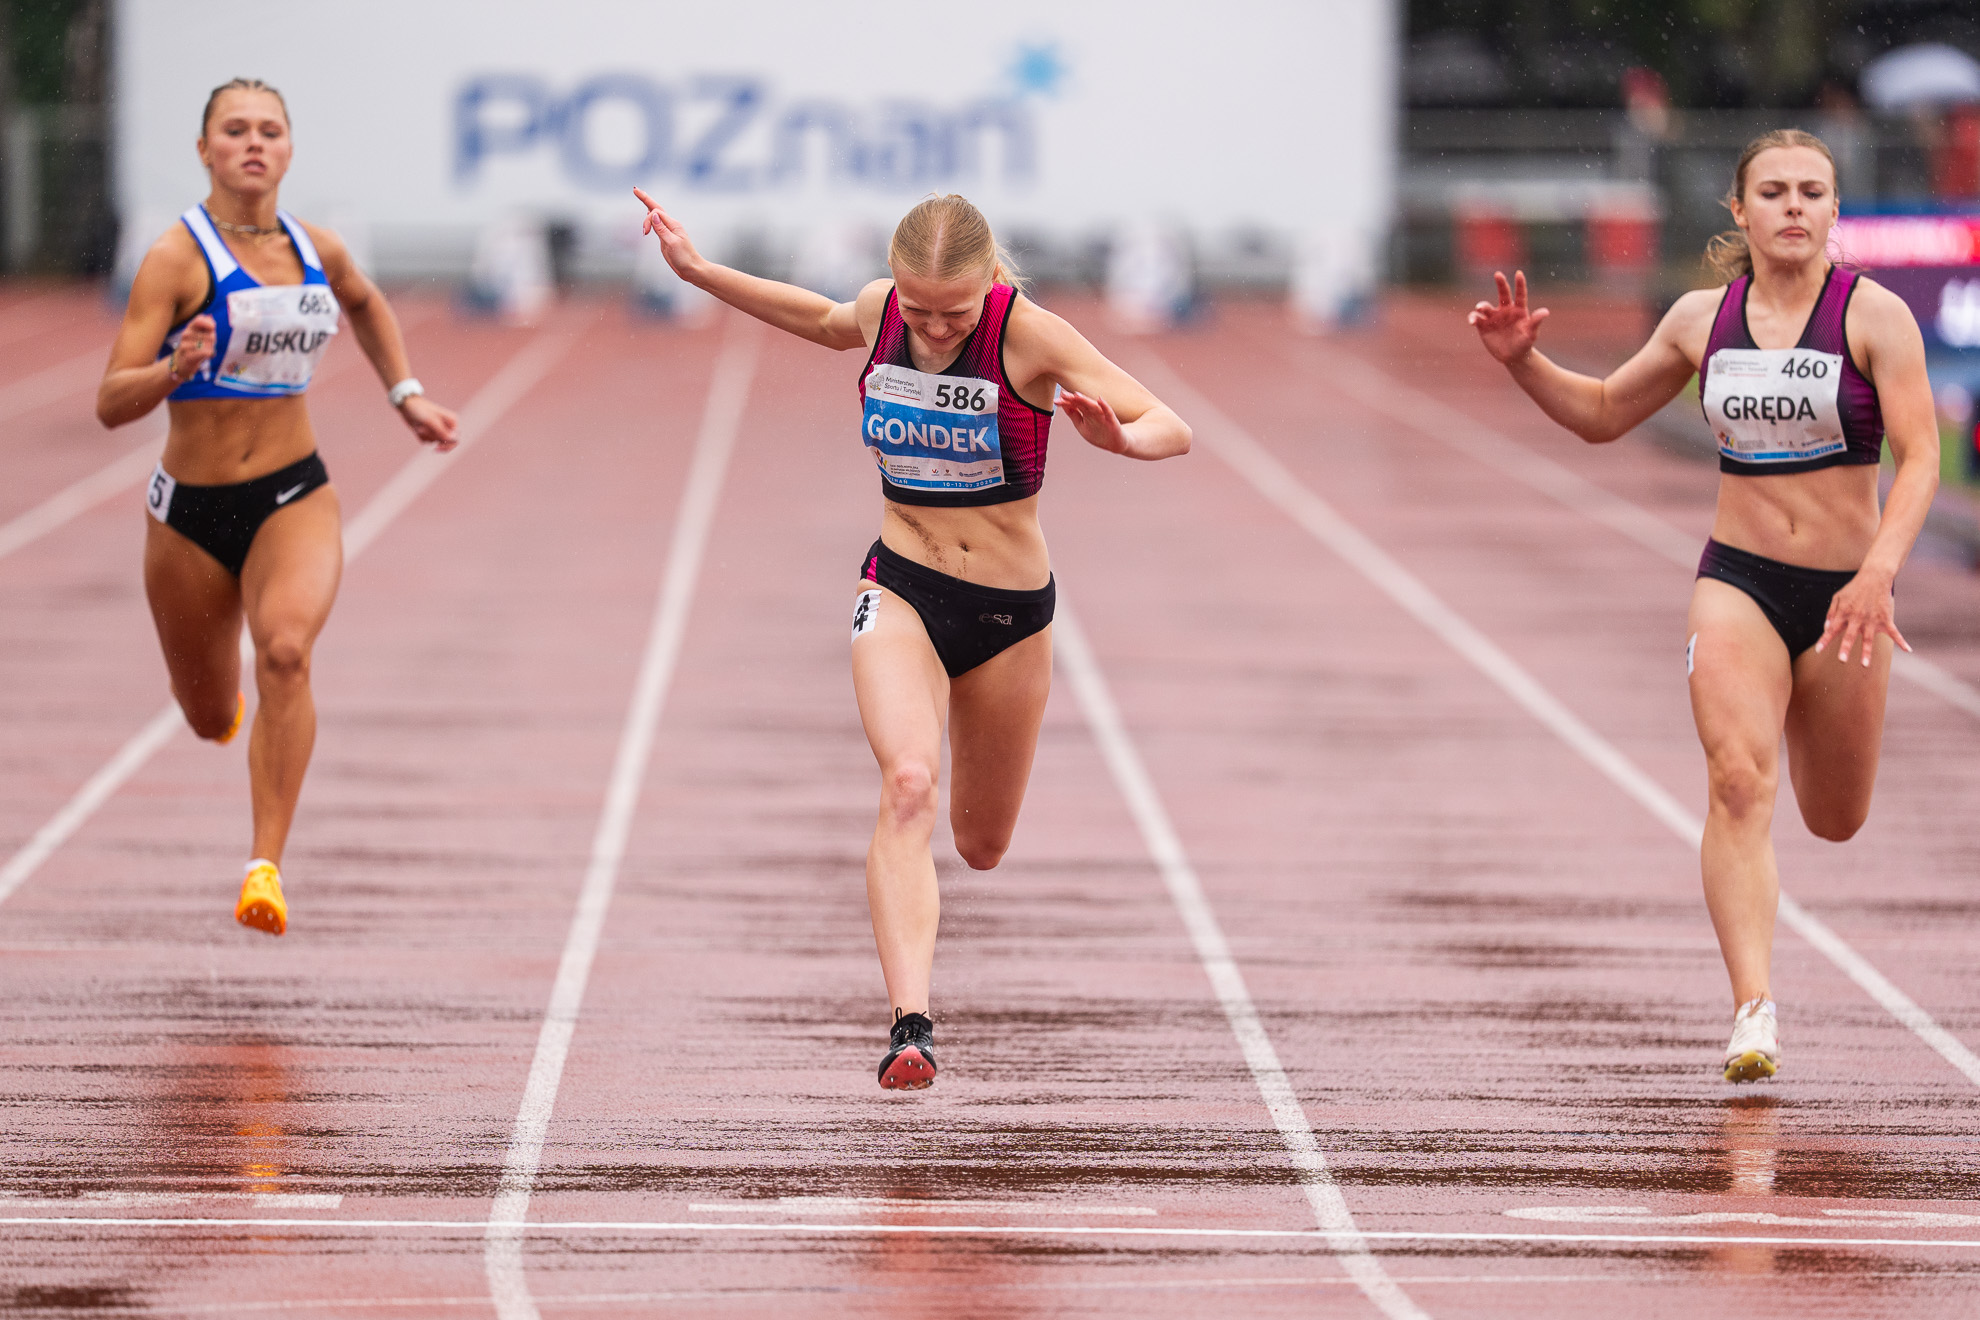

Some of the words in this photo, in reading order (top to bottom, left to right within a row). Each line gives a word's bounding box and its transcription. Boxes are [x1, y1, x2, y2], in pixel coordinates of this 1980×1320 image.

[245, 331, 328, 354] BISKUP
[885, 376, 915, 388] Ministerstwo
[1781, 357, 1828, 379] 460
[935, 384, 986, 411] 586
[1723, 396, 1817, 425] GRĘDA
[867, 414, 992, 453] GONDEK
[149, 473, 167, 509] 5
[853, 594, 871, 632] 4
